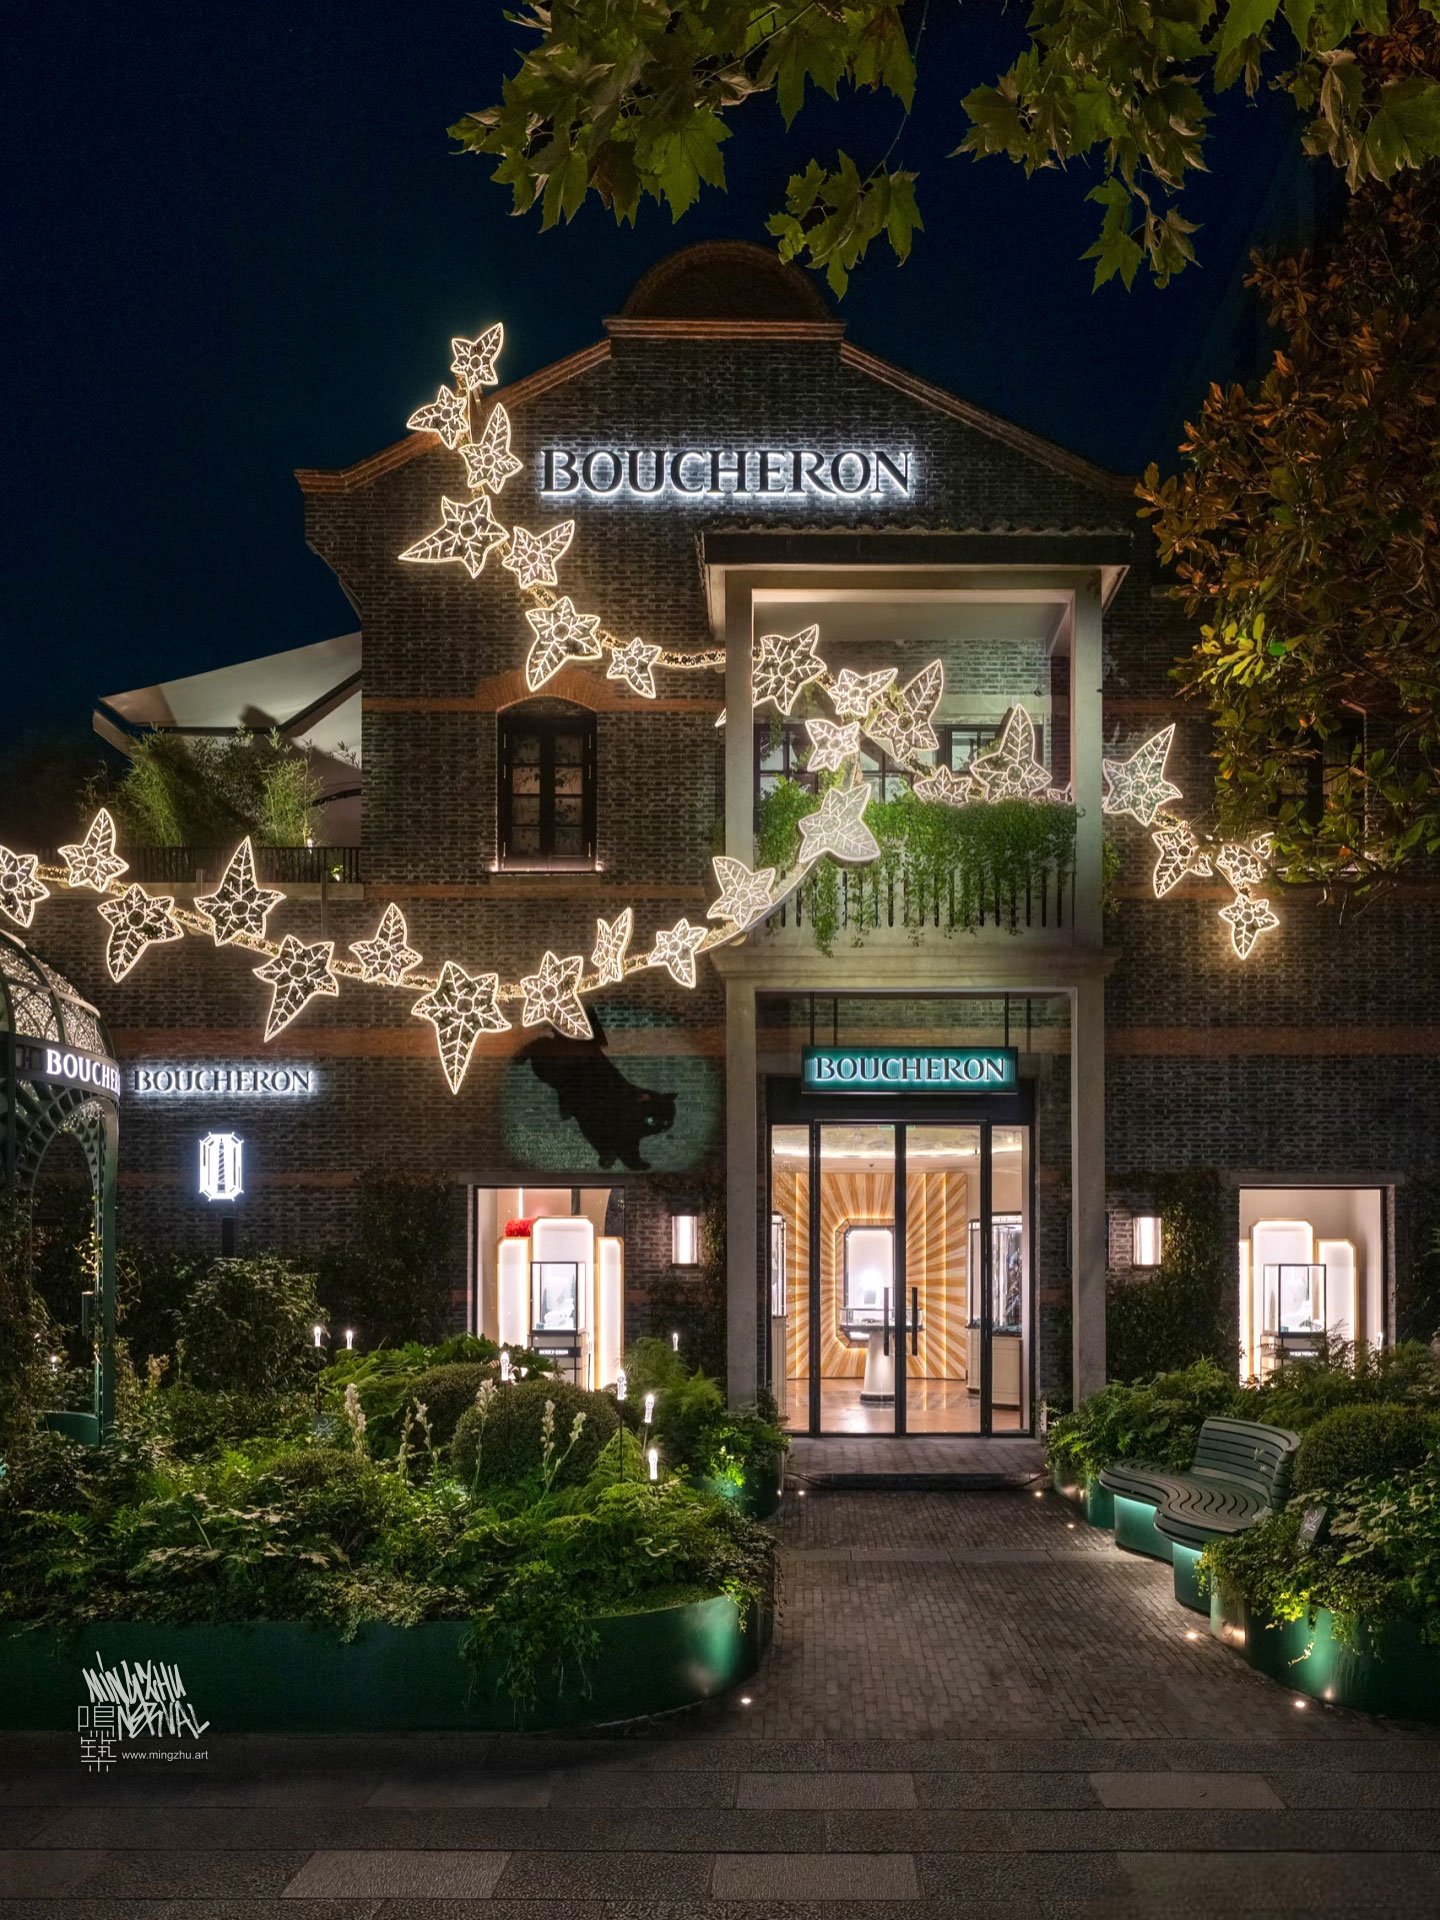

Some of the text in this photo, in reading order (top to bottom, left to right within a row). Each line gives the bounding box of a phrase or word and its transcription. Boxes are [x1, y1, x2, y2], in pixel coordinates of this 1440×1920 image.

[540, 449, 912, 497] BOUCHERON
[134, 1069, 312, 1092] BOUCHERON
[814, 1056, 1005, 1082] BOUCHERON
